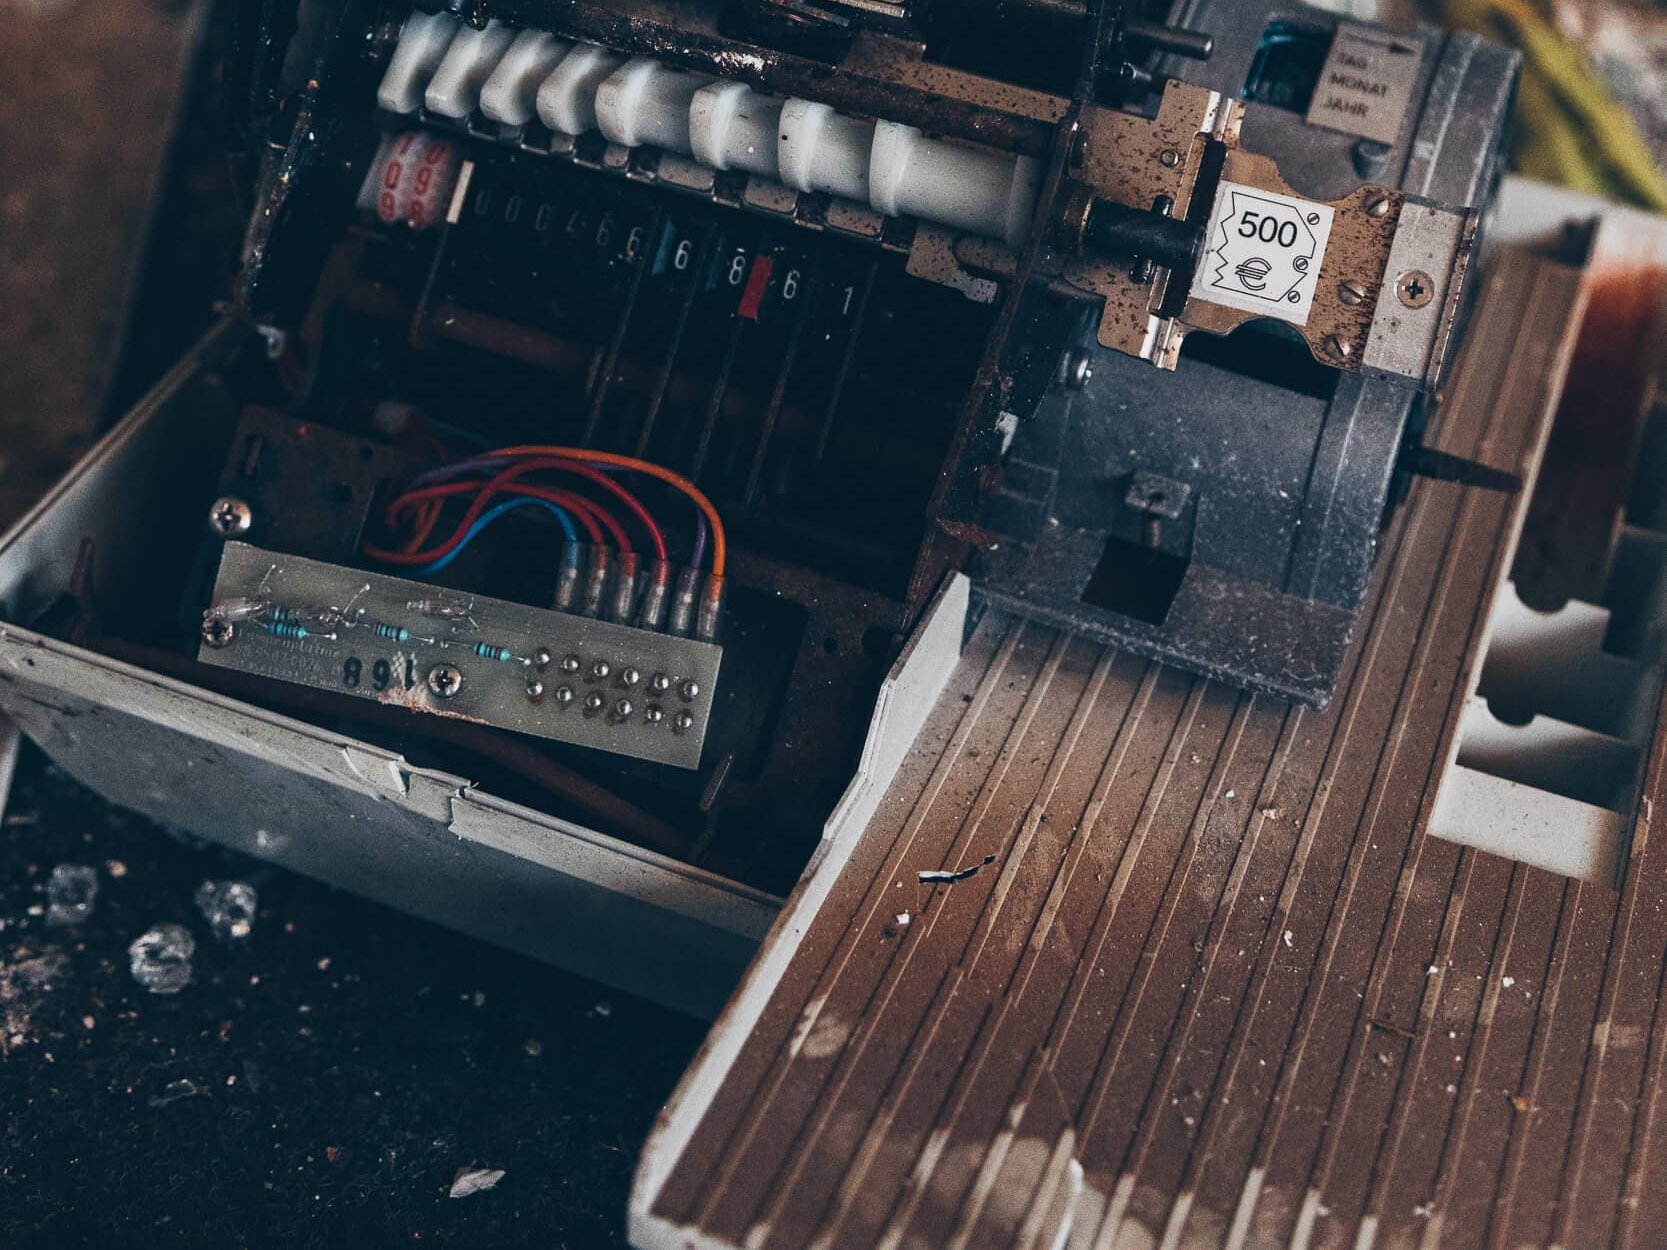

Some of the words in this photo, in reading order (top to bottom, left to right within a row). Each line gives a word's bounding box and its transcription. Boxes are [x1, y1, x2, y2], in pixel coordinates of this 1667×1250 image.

[1338, 52, 1367, 69] TAG
[1331, 72, 1388, 97] MONAT
[1324, 96, 1368, 117] JAHR
[1238, 210, 1297, 248] 500
